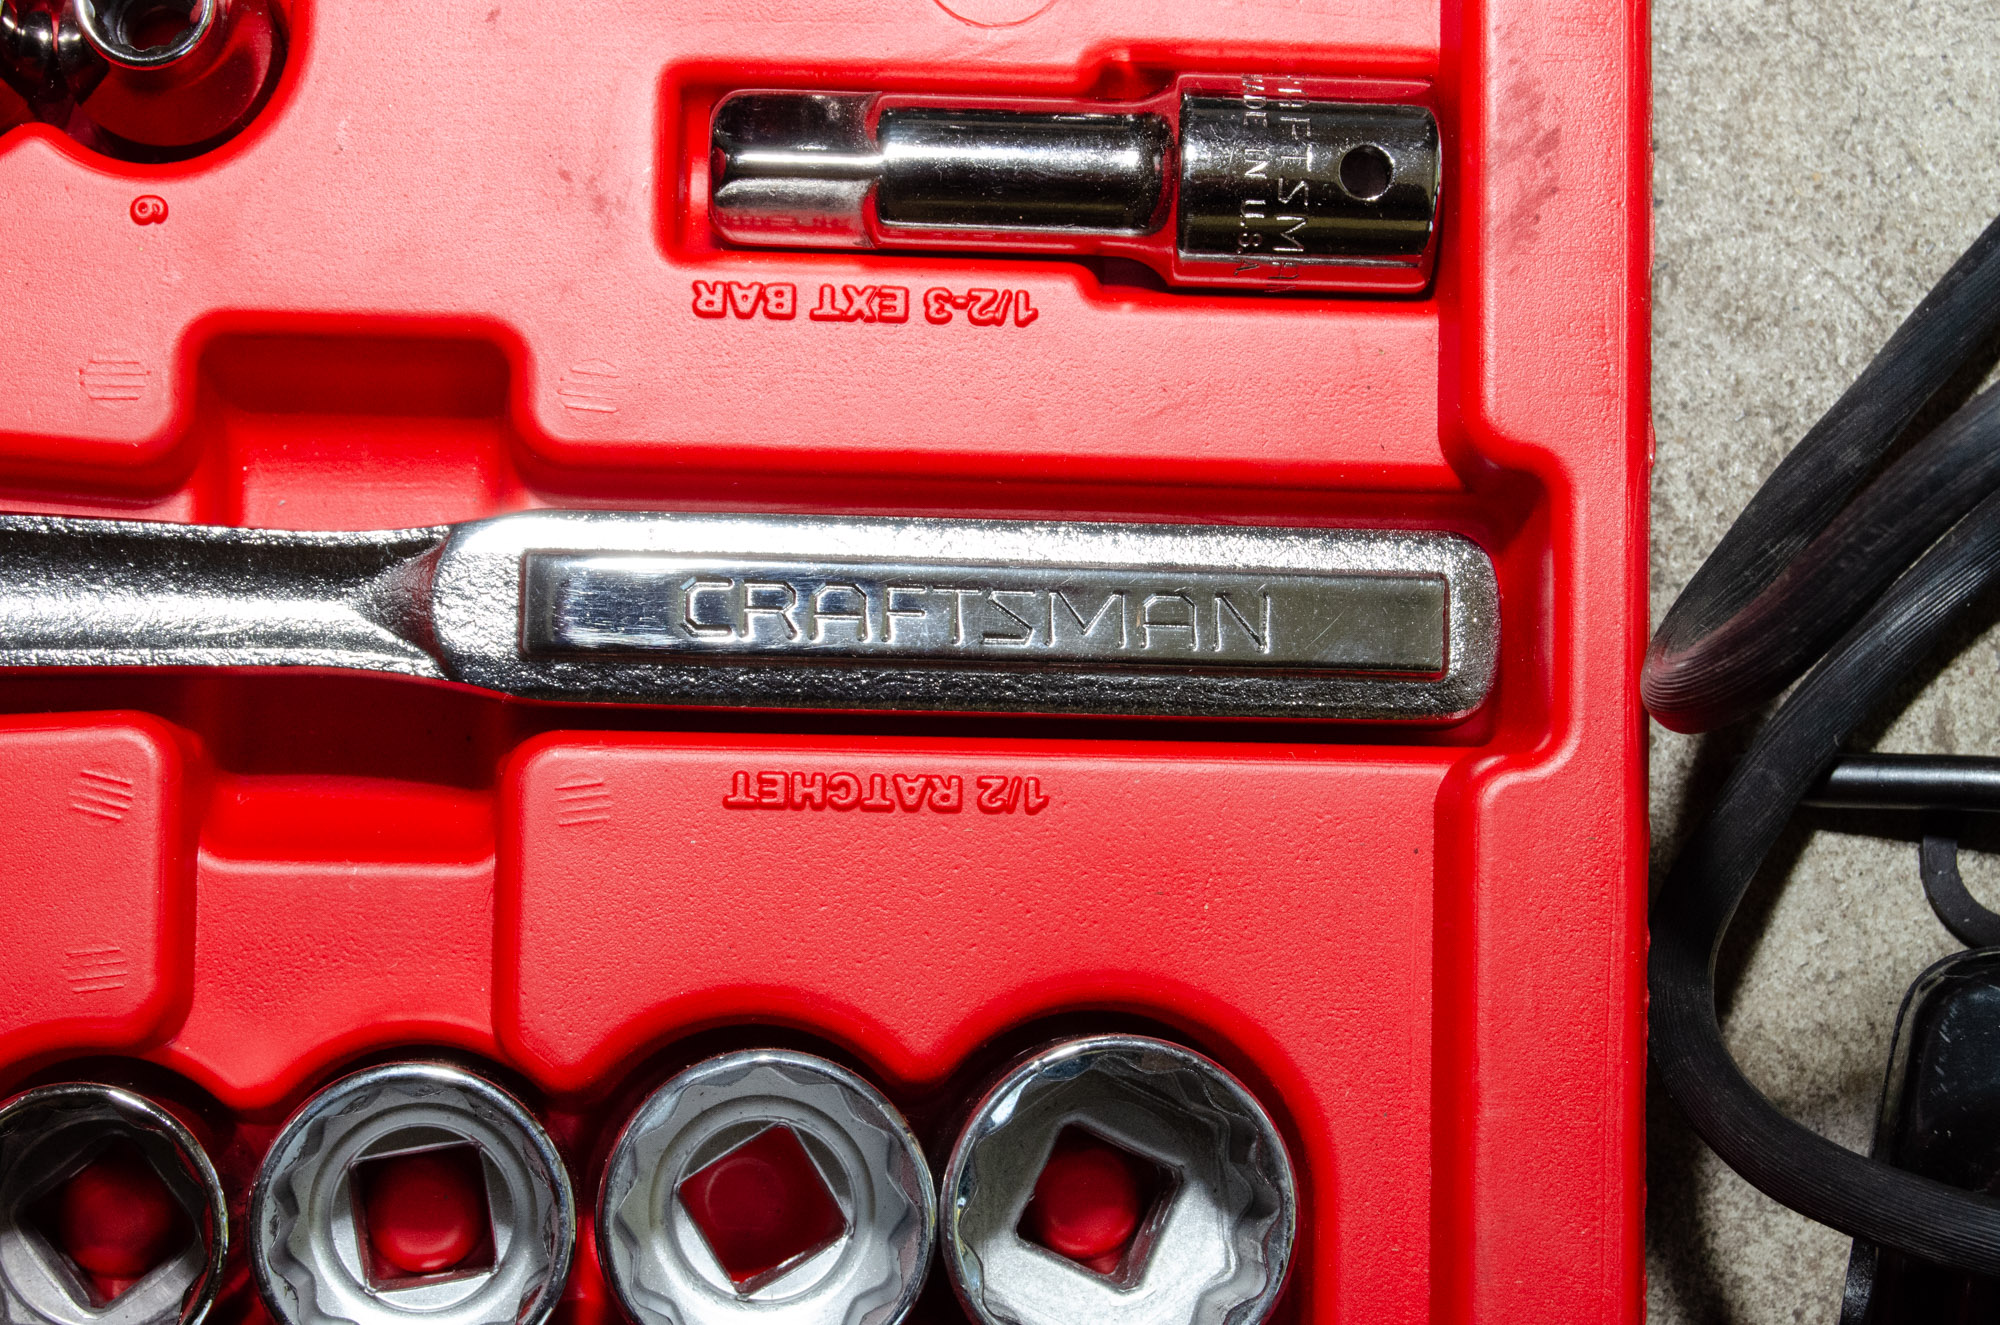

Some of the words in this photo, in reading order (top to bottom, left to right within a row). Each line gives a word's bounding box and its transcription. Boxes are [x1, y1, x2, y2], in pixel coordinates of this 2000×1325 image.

[1242, 73, 1268, 128] MADE
[1244, 147, 1270, 179] IN
[692, 280, 796, 320] BAR
[809, 283, 909, 324] EXT
[923, 286, 1039, 328] 1/2-3
[680, 577, 1271, 654] CRAFTSMAN
[723, 770, 963, 814] RATCHET
[976, 775, 1049, 815] 1/2
